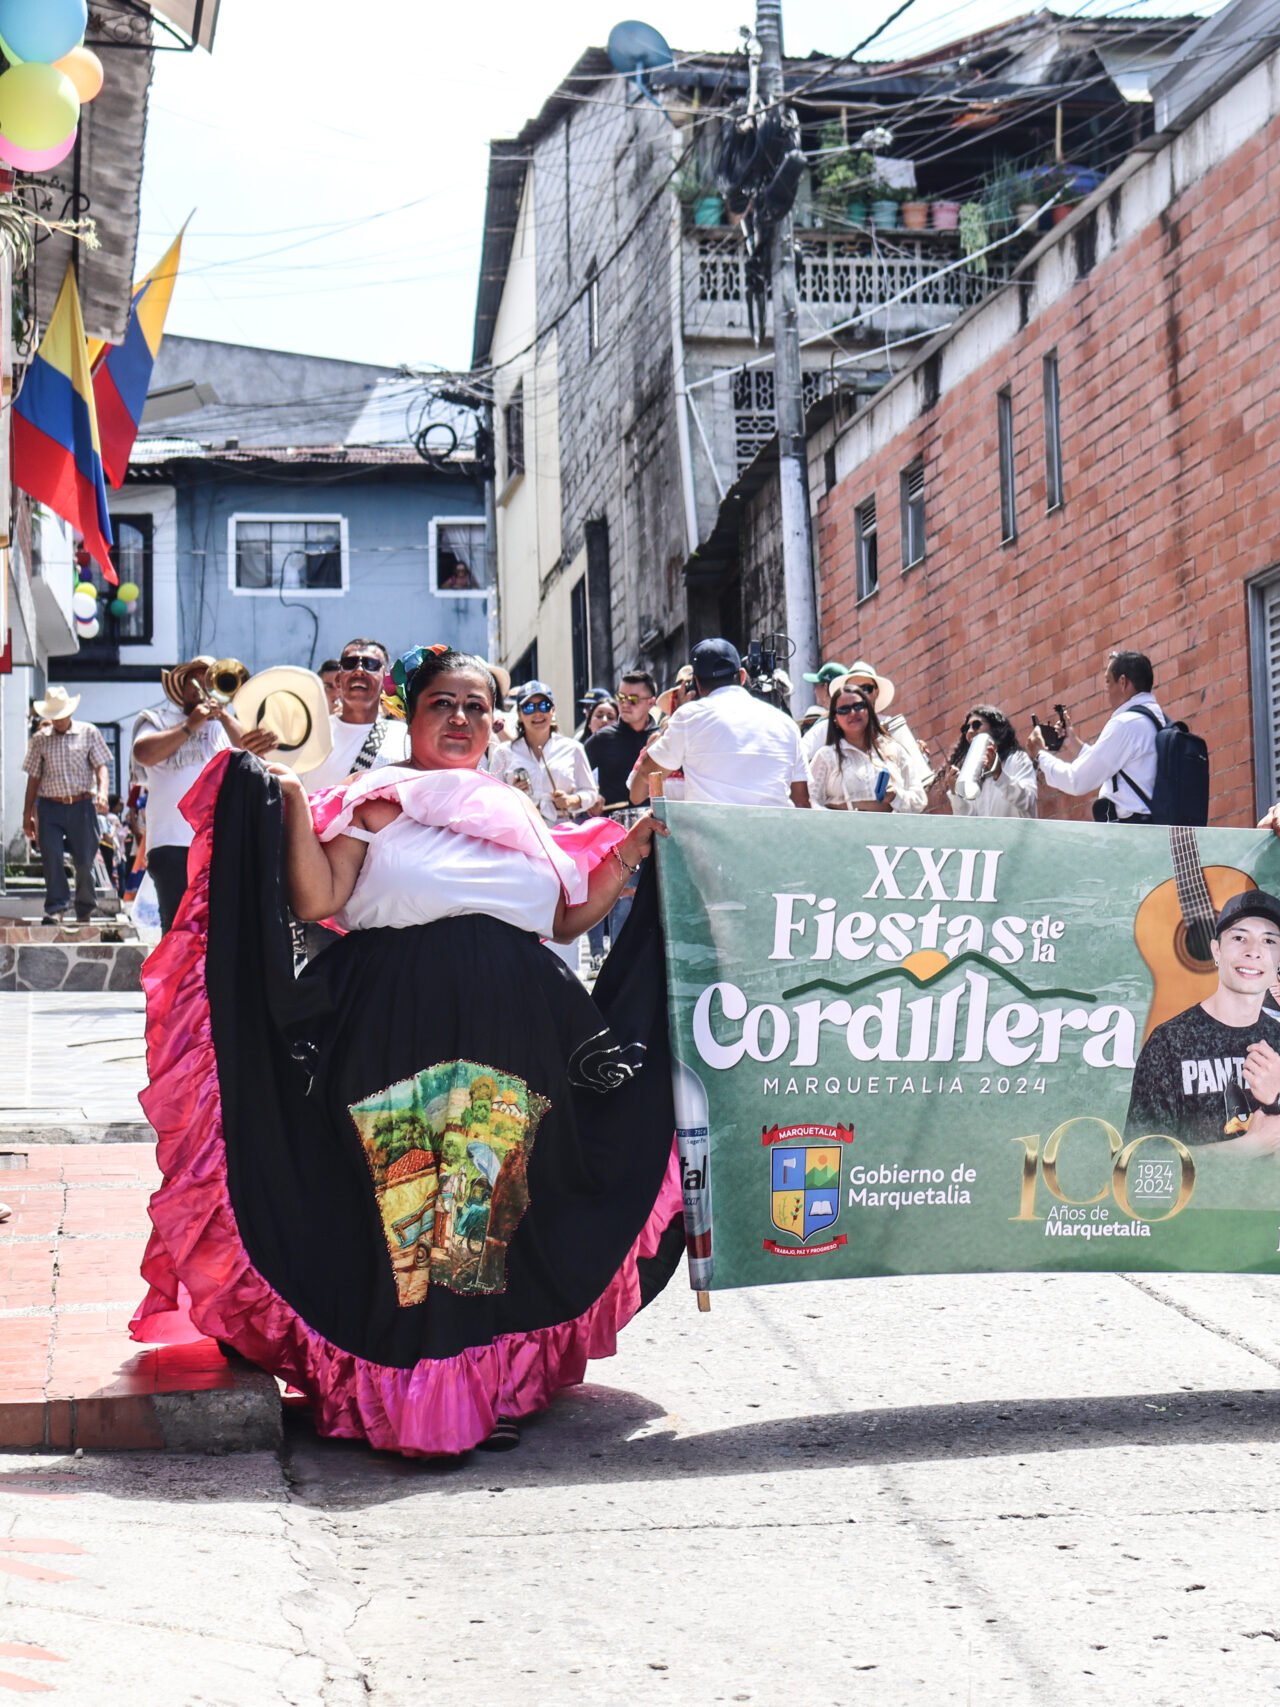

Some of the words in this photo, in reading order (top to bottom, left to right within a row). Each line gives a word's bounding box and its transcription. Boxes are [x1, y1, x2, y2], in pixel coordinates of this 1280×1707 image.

[862, 845, 1004, 903] XXII
[768, 893, 1028, 965] Fiestas
[1031, 915, 1065, 940] de
[1031, 938, 1057, 963] la
[692, 970, 1137, 1070] Cordillera
[763, 1076, 964, 1095] MARQUETALIA
[979, 1076, 1047, 1095] 2024
[778, 1127, 837, 1139] MARQUETALIA
[850, 1164, 945, 1185] Gobierno
[951, 1163, 977, 1183] de
[1008, 1116, 1196, 1222] 100
[1137, 1164, 1173, 1179] 1924
[1134, 1179, 1175, 1194] 2024
[848, 1185, 972, 1211] Marquetalia
[1047, 1205, 1085, 1221] Años
[1090, 1205, 1109, 1221] de
[1045, 1220, 1151, 1240] Marquetalia
[774, 1247, 795, 1255] TRABAJO,
[810, 1243, 838, 1254] PROGRESO
